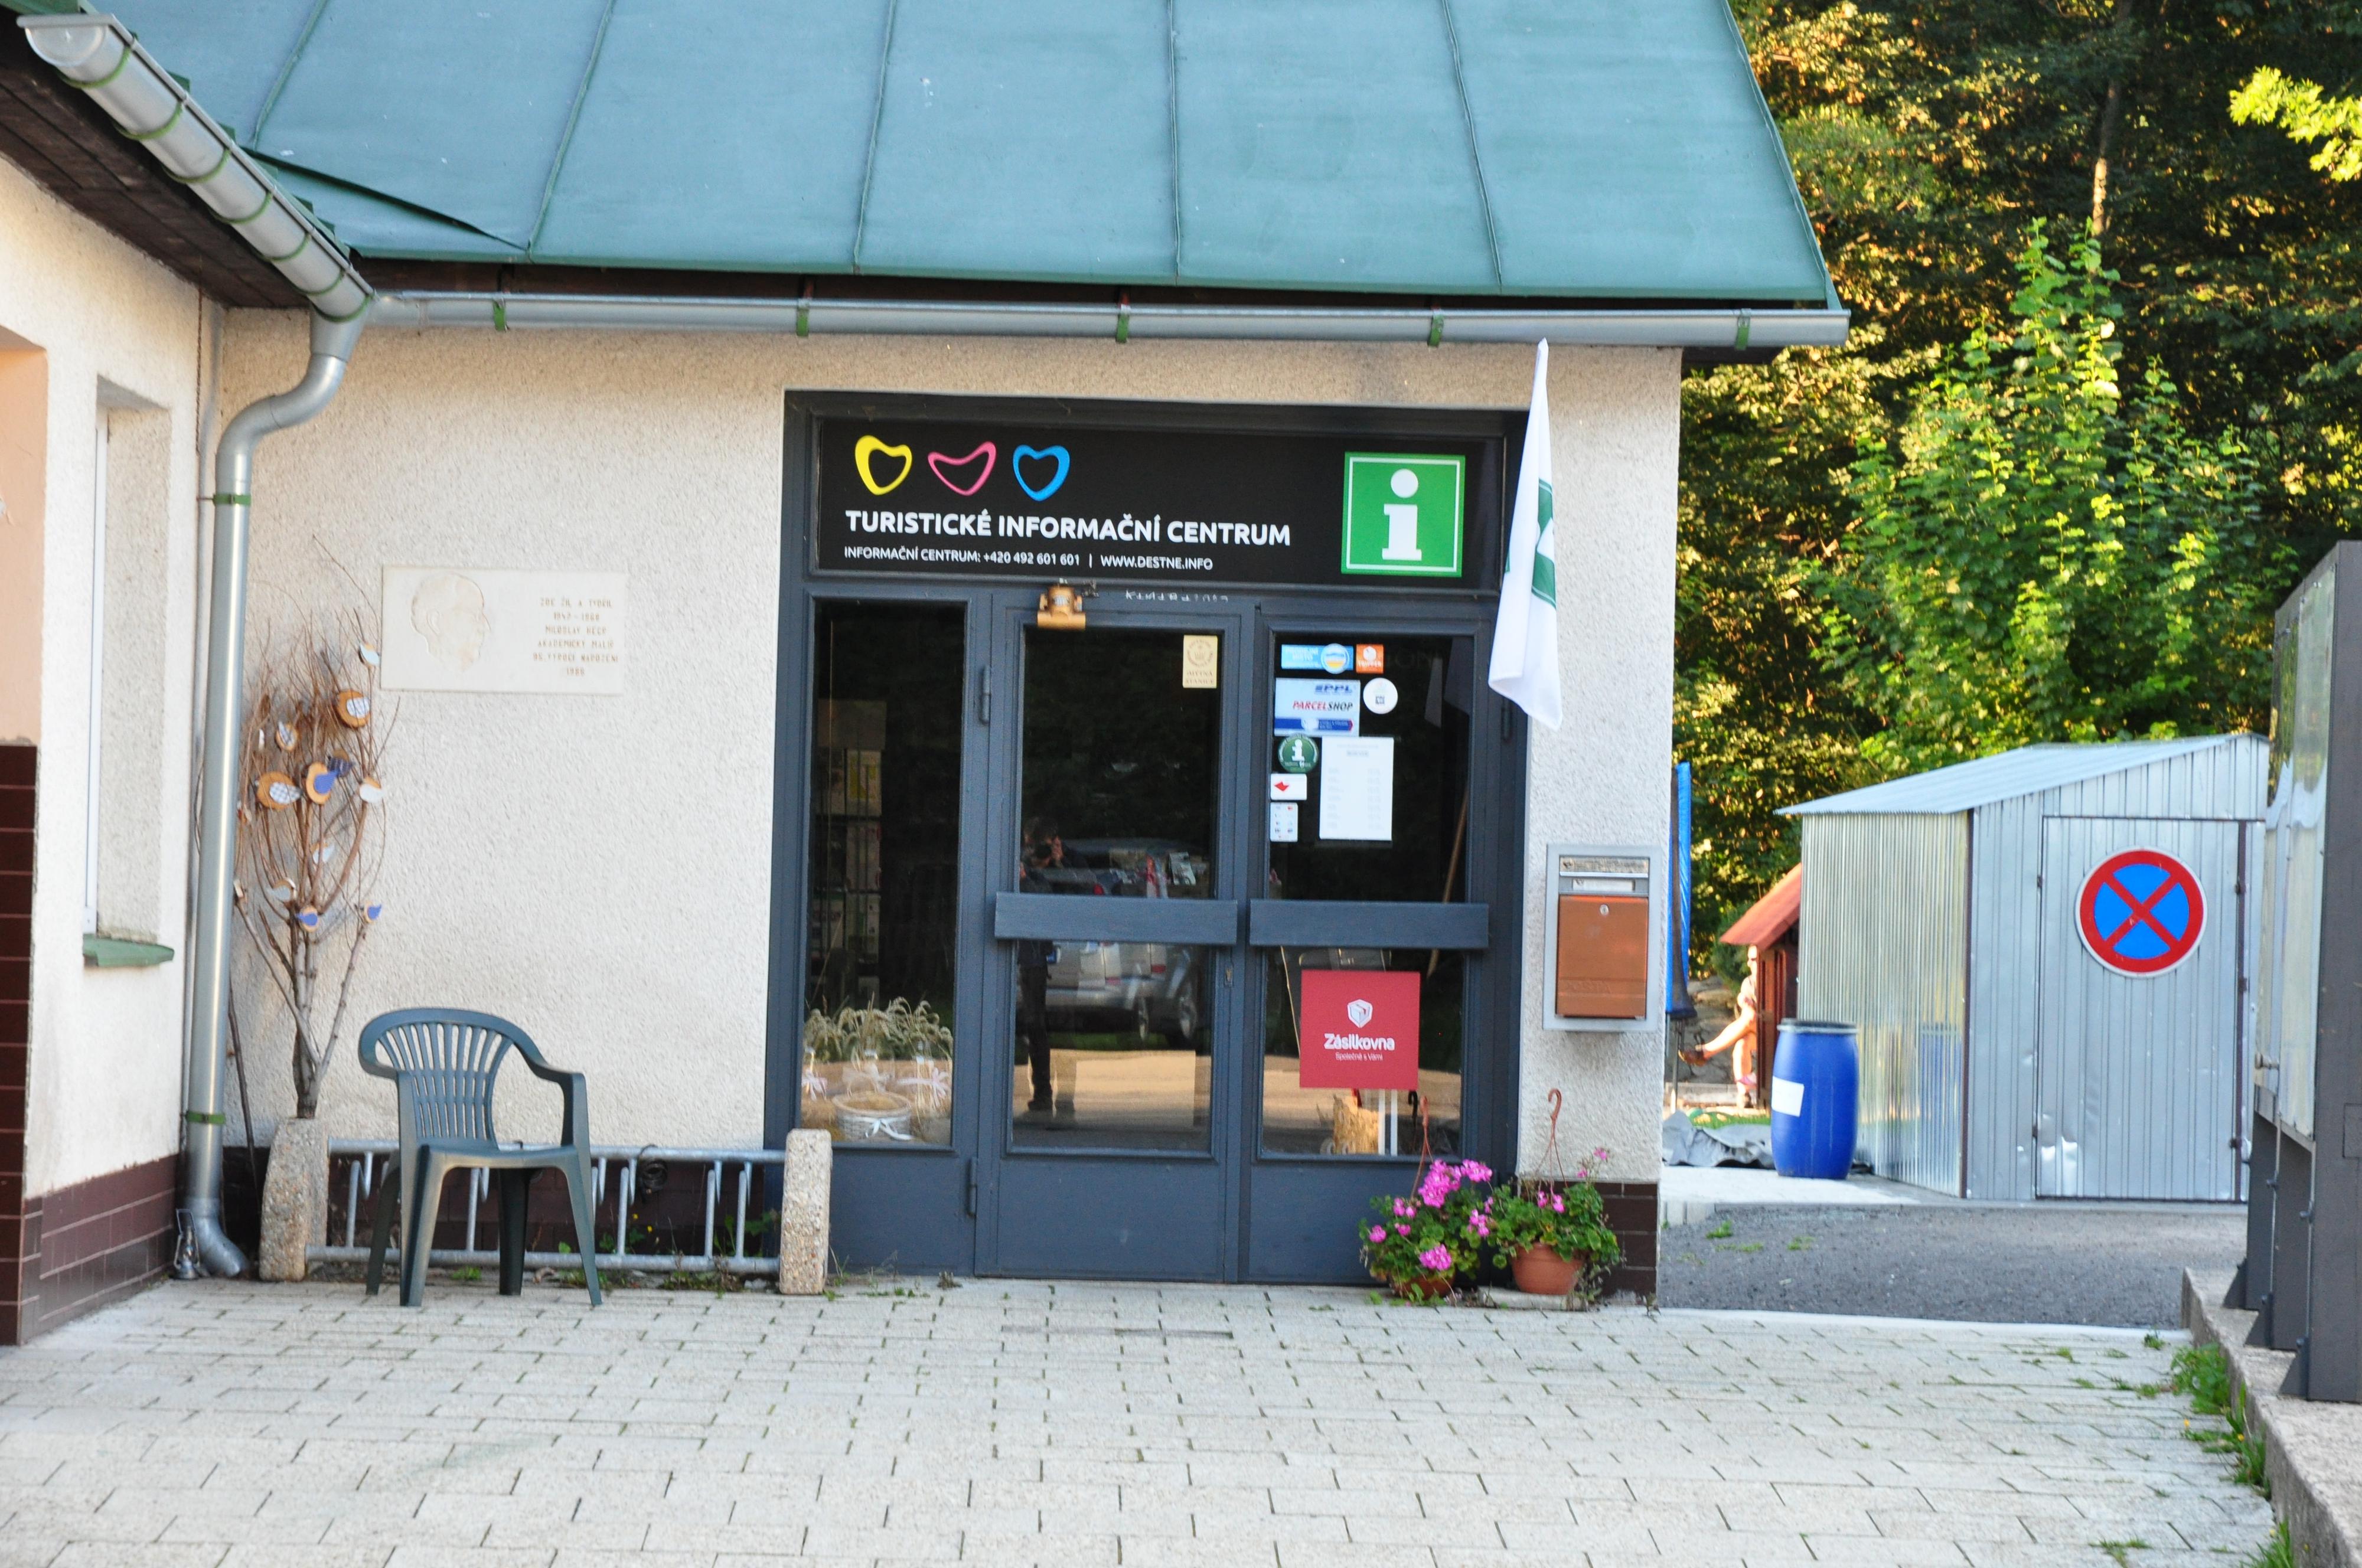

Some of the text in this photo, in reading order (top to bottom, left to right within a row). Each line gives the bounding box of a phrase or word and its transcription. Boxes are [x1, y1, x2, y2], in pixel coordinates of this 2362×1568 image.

[845, 508, 1291, 547] TURISTICKÉ INFORMAČNÍ CENTRUM
[844, 545, 919, 561] INFORMAČNÍ
[921, 548, 981, 563] CENTRUM:
[983, 551, 1012, 564] +420
[1013, 552, 1034, 565] 492
[1036, 553, 1056, 566] 601
[1060, 554, 1080, 567] 601
[1100, 554, 1214, 571] WWW.DESTNE.INFO
[1324, 1033, 1395, 1050] Zásilkovna
